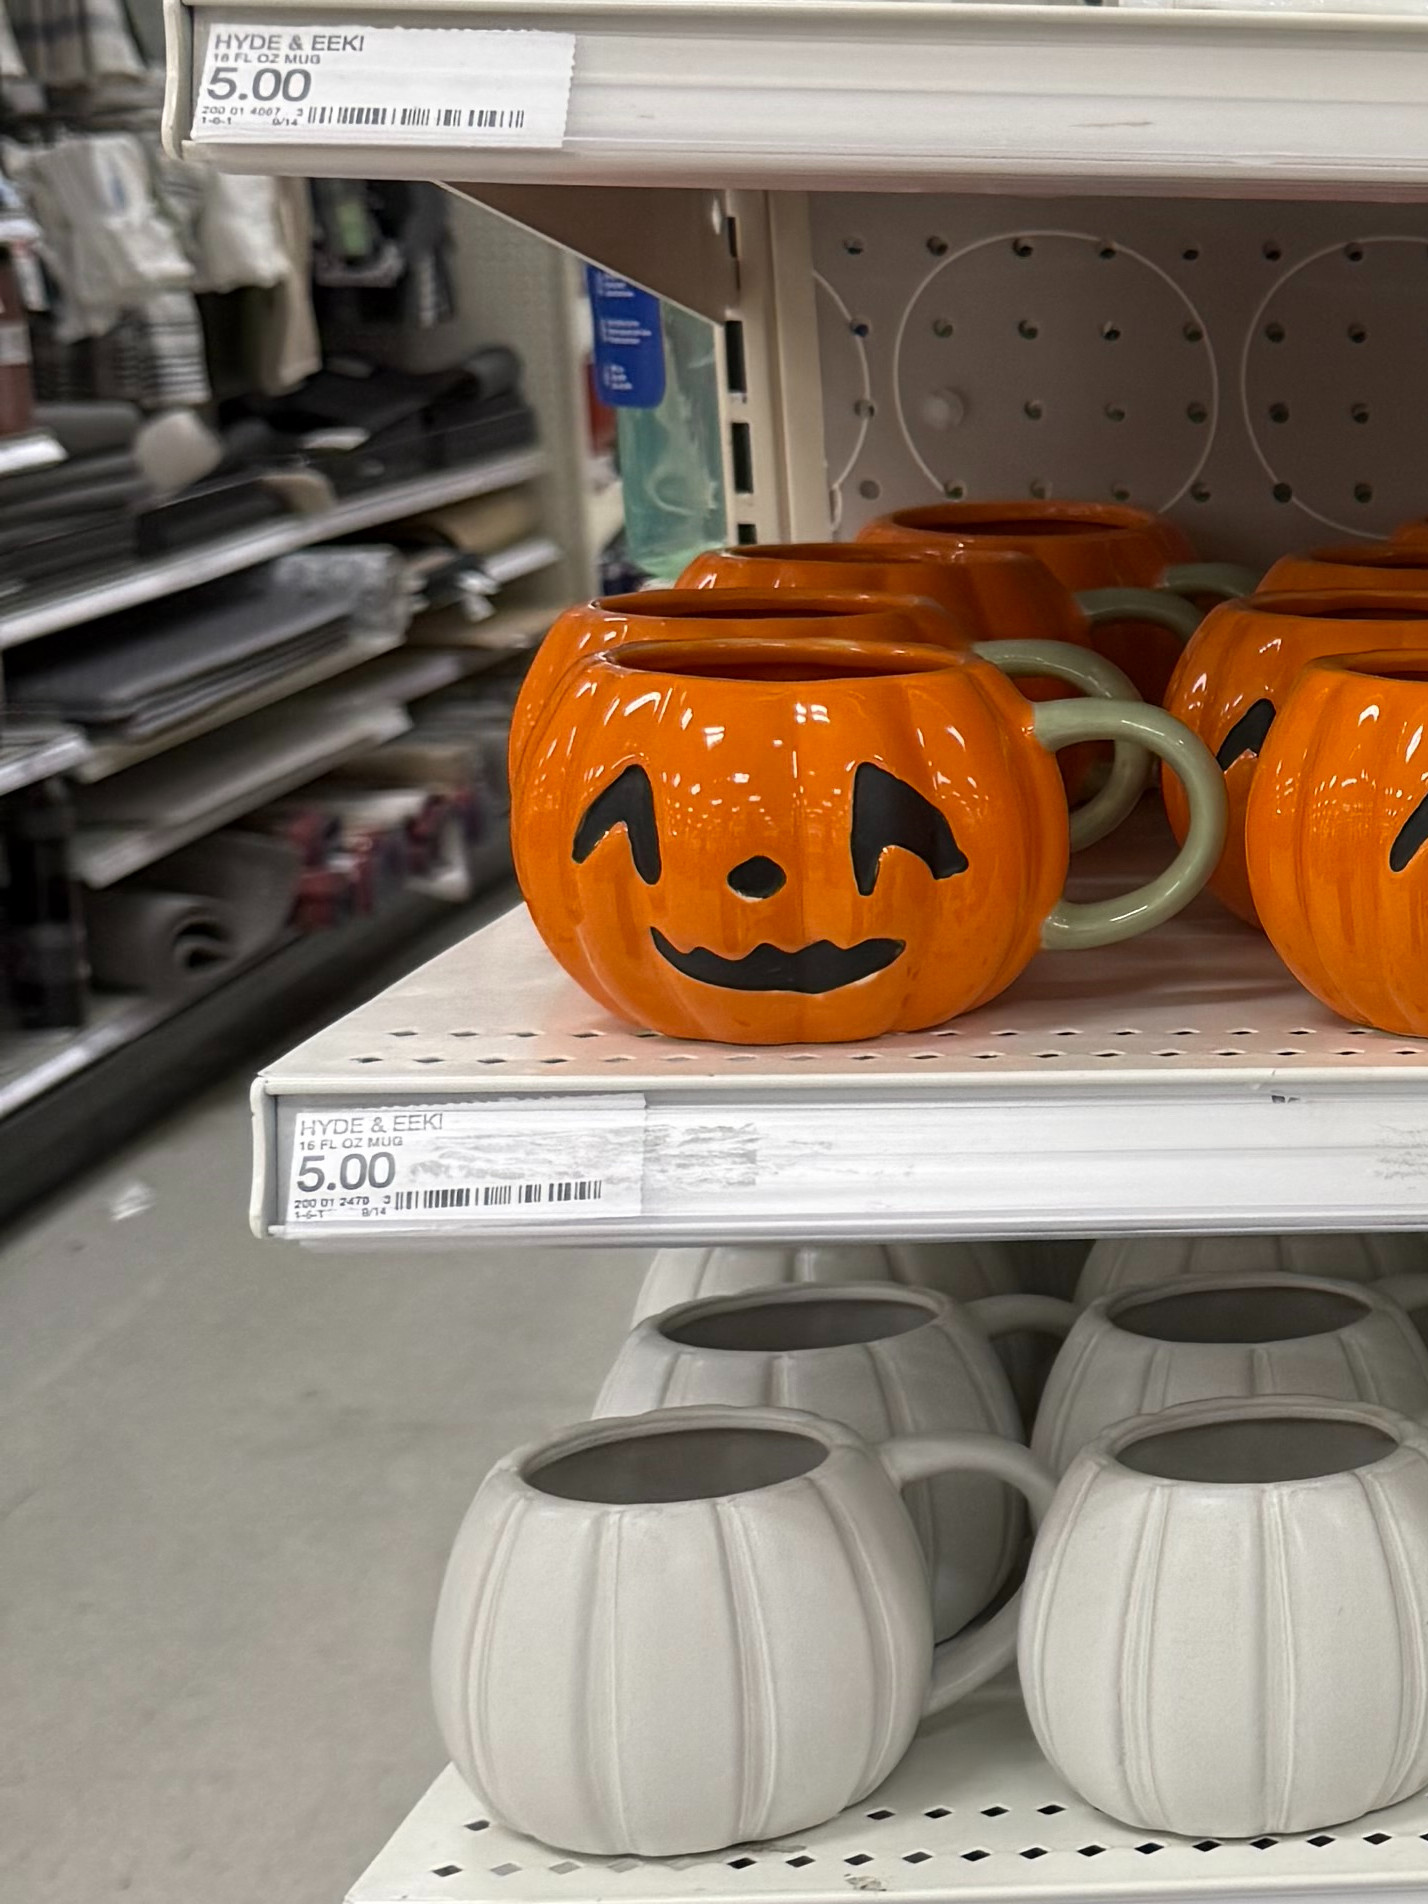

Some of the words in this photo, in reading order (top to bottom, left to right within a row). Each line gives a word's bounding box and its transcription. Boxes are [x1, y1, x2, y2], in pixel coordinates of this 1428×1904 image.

[215, 34, 281, 51] HYDE
[289, 35, 305, 51] &
[234, 53, 252, 64] FL
[257, 54, 279, 64] OZ
[284, 54, 321, 65] MUG
[206, 67, 312, 102] 5.00
[301, 1118, 363, 1136] HYDE
[372, 1119, 386, 1133] &
[300, 1141, 316, 1151] 16
[320, 1139, 338, 1150] FL
[341, 1138, 363, 1148] OZ
[368, 1137, 403, 1147] MUG
[297, 1152, 395, 1192] 5.00
